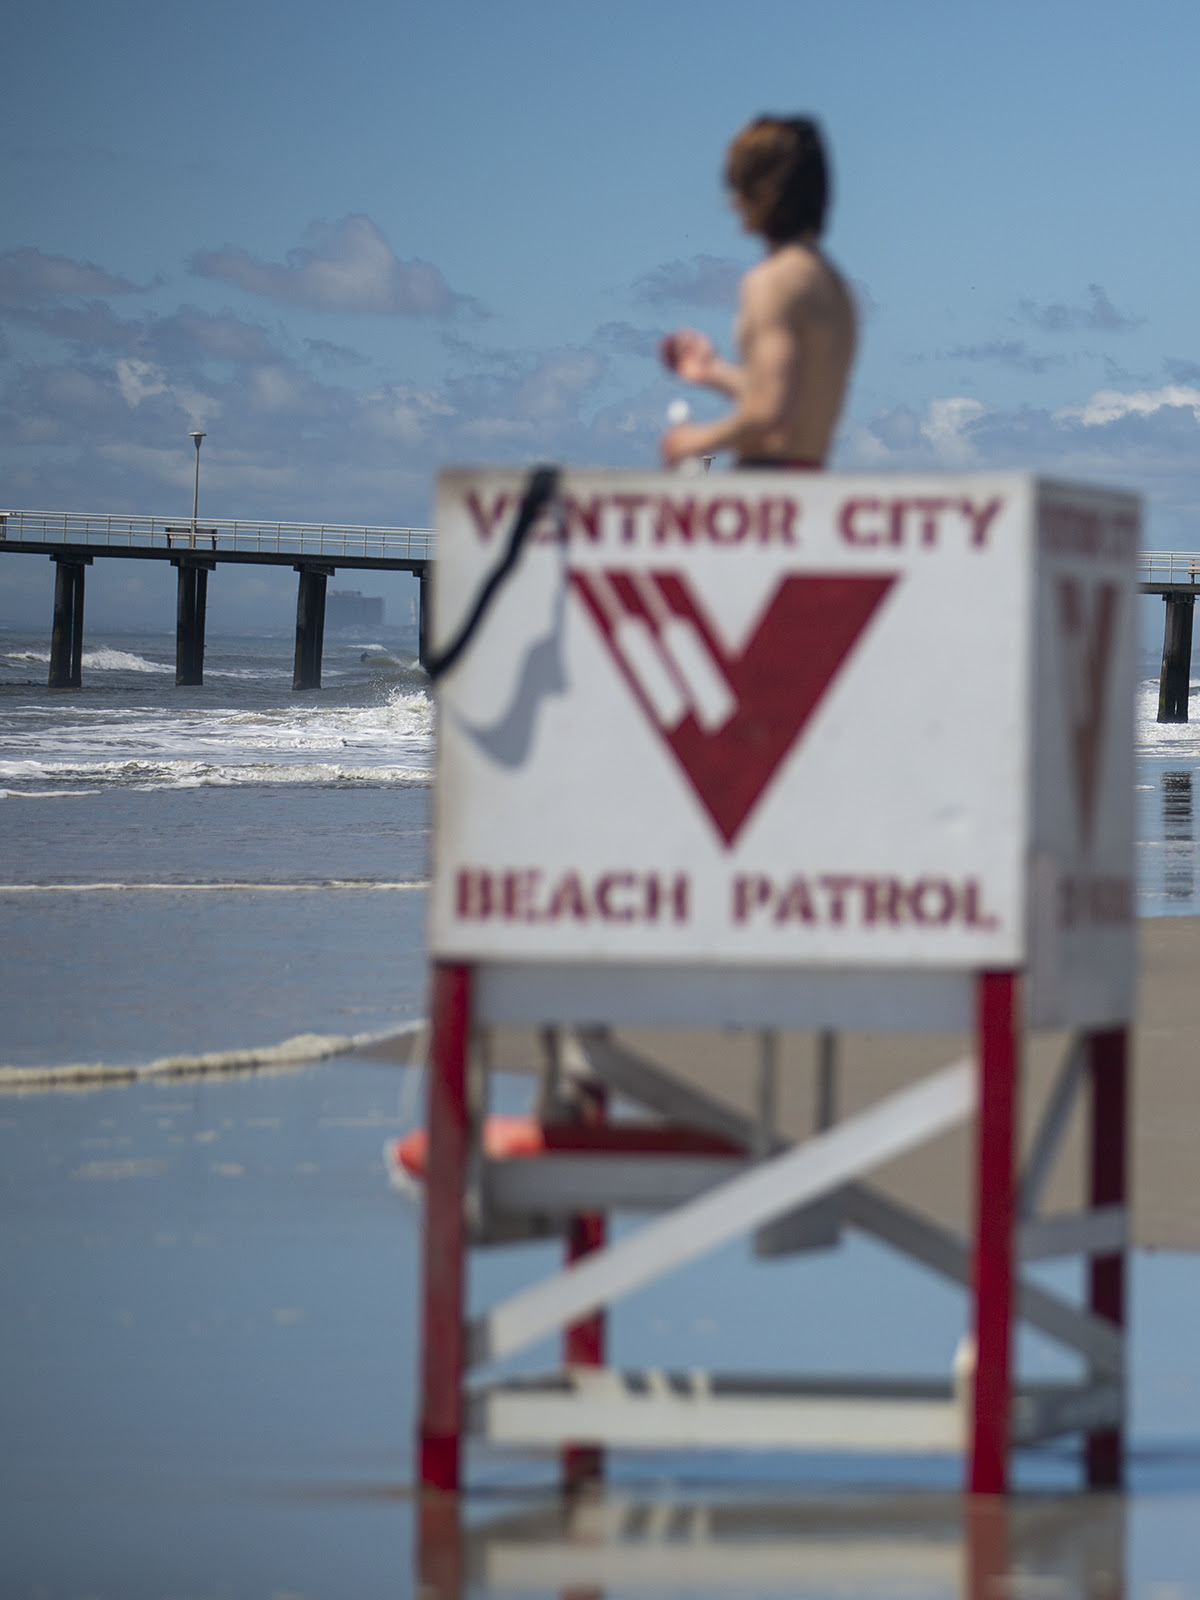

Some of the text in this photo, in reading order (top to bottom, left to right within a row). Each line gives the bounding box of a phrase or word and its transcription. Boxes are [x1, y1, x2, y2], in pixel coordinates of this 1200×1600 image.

[836, 496, 1004, 549] CITY
[455, 867, 690, 925] BEACH
[731, 873, 1000, 931] PATROL
